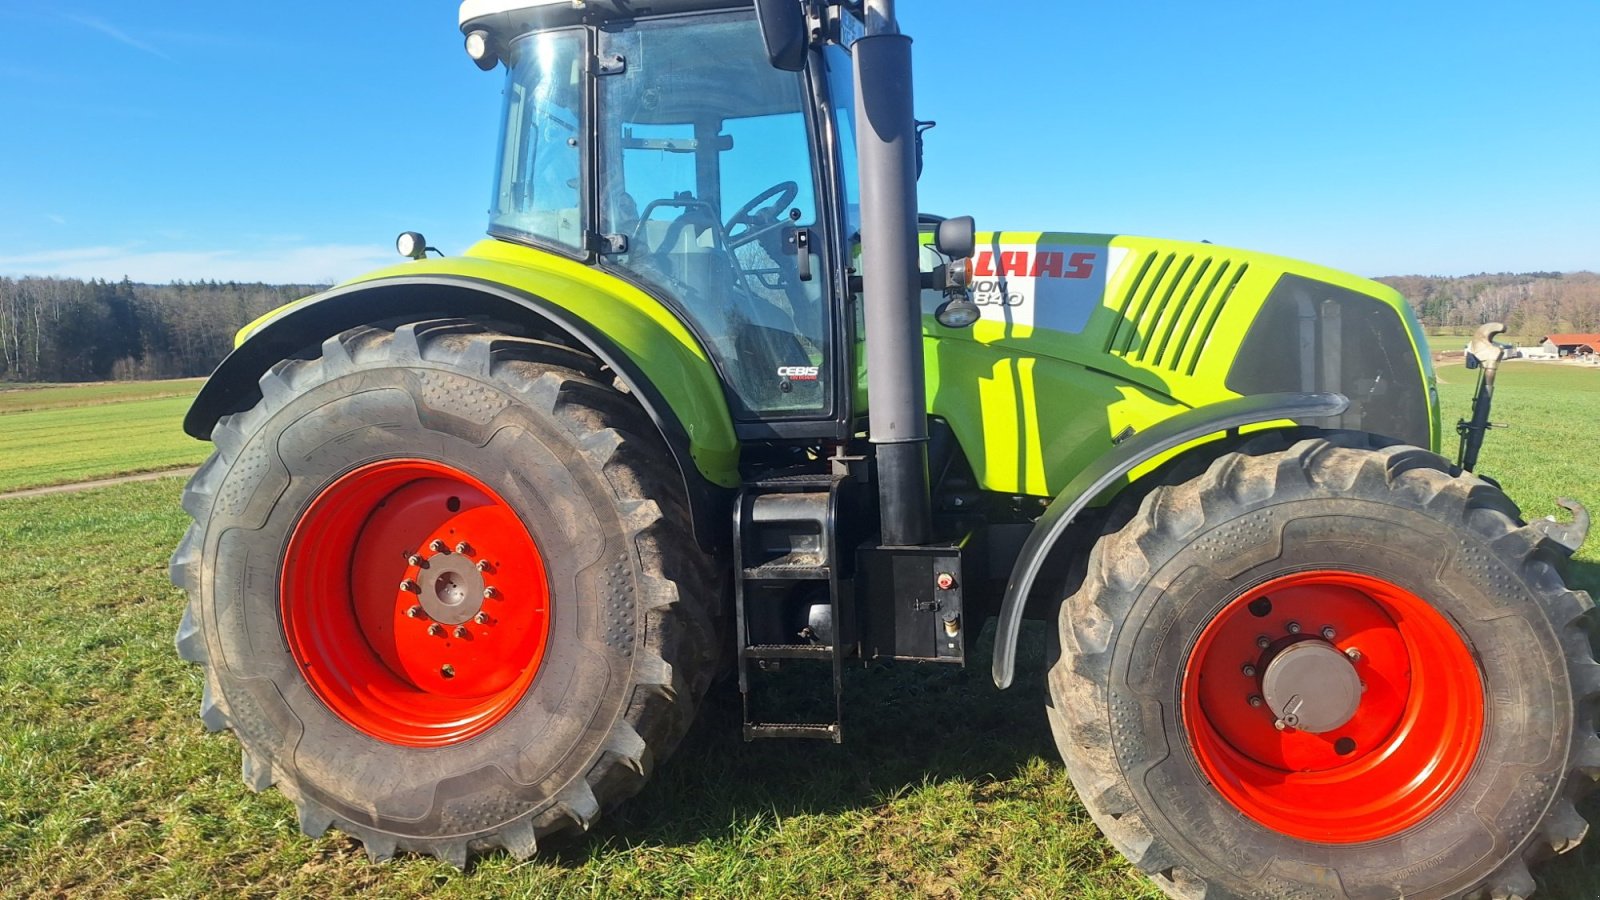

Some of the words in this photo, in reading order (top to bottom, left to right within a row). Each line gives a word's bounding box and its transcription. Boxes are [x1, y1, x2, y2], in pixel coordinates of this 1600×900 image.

[974, 251, 1096, 279] LAAS
[970, 280, 1008, 293] ION
[974, 291, 1025, 307] 840
[777, 366, 819, 376] CEBIS
